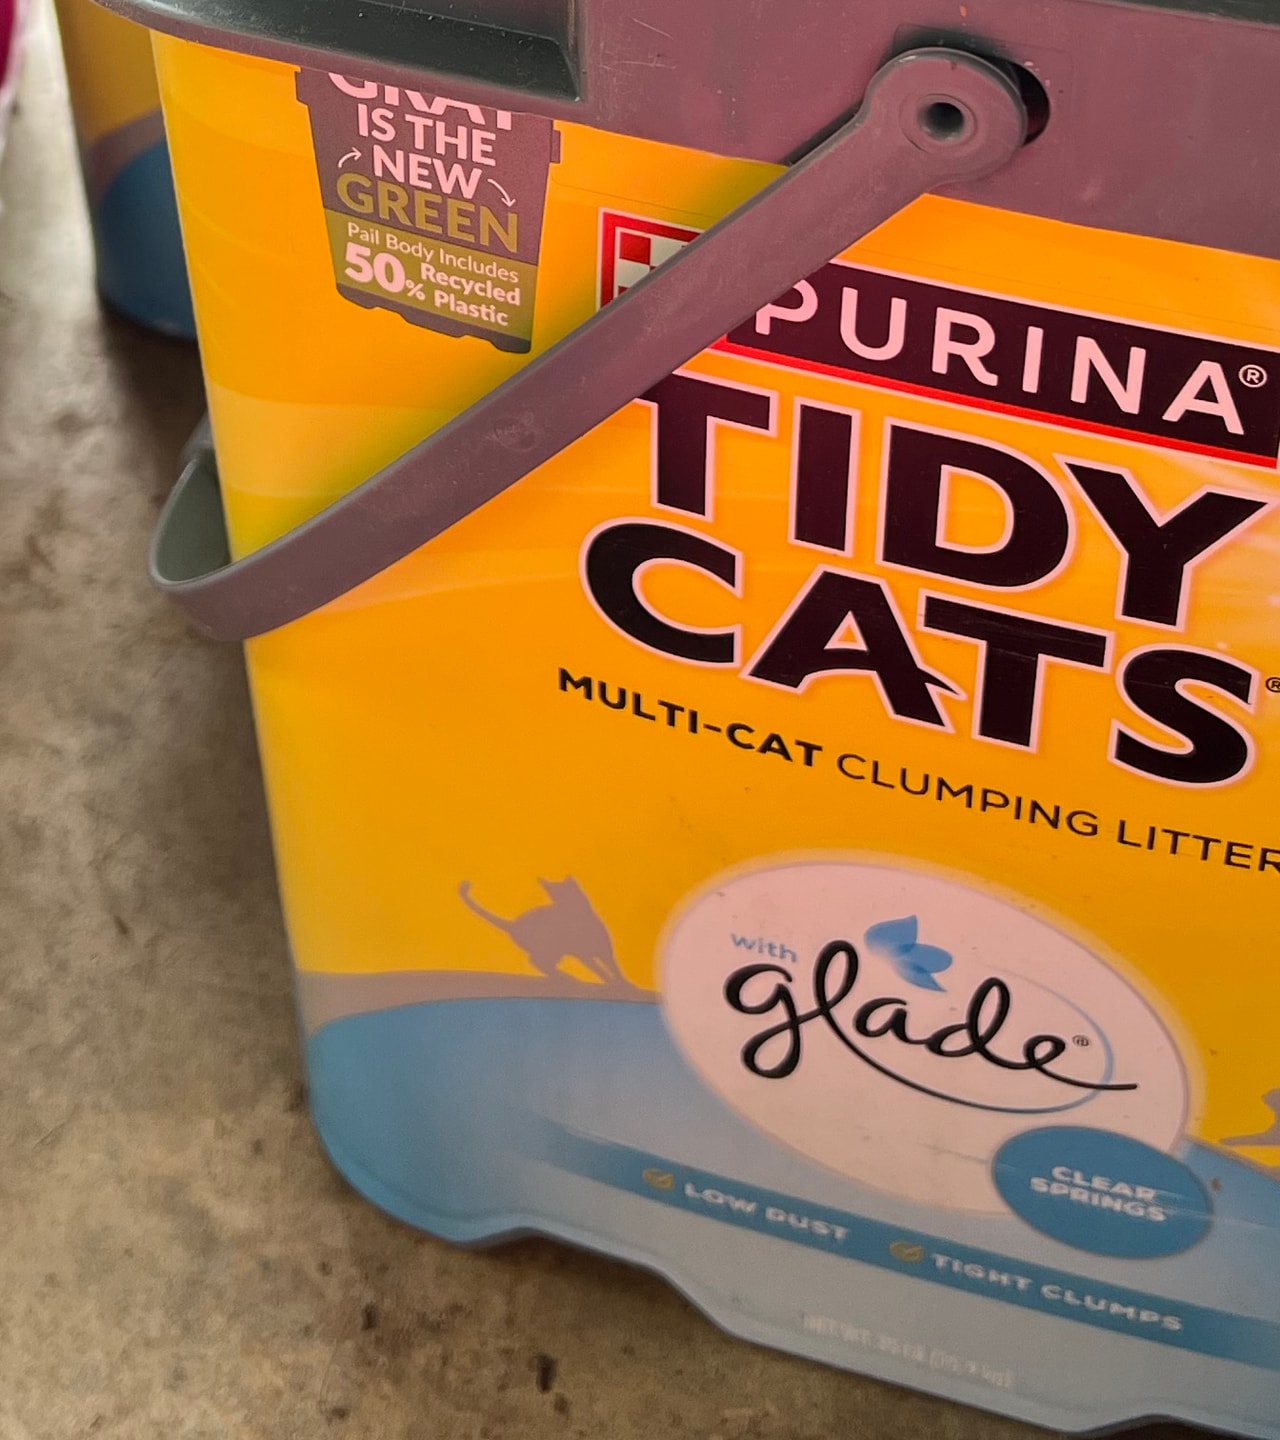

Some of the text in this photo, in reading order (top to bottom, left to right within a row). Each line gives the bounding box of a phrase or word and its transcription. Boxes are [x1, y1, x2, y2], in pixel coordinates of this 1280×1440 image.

[358, 103, 496, 167] IS THE
[373, 144, 482, 199] NEW
[336, 172, 518, 253] GREEN
[345, 242, 426, 300] 50%
[348, 222, 519, 283] Pail Body Includes
[420, 262, 520, 306] Recycled
[434, 290, 509, 326] Plastic
[634, 372, 1276, 628] TIDY
[558, 667, 823, 768] MULTI-CAT
[836, 752, 1101, 839] CLUMPING
[731, 933, 797, 963] with
[1030, 1176, 1168, 1223] SPRINGS
[1051, 1165, 1157, 1202] CLEAR
[683, 1182, 1183, 1331] LOW DUST TIGHT CLUMPS
